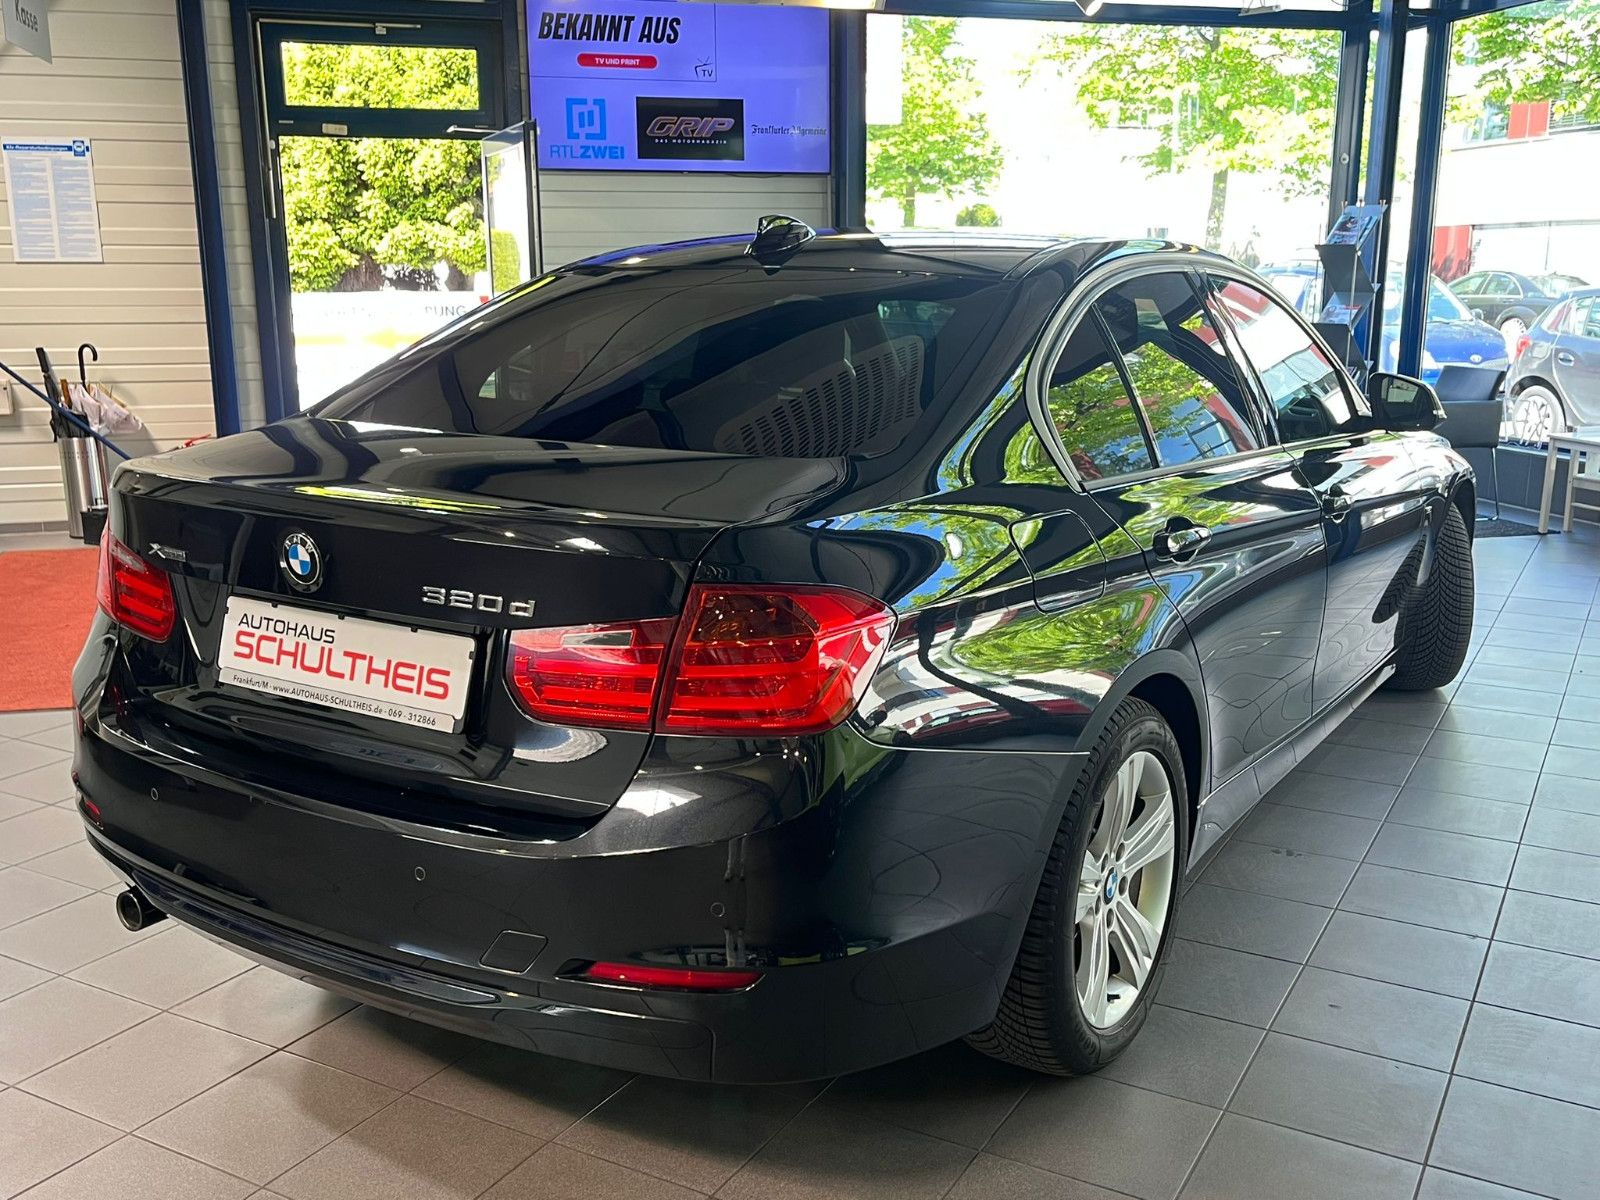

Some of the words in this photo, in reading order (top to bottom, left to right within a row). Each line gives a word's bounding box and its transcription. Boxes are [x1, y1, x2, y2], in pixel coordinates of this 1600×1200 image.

[15, 0, 38, 32] Kasse
[538, 12, 635, 42] BEKANNT
[638, 16, 681, 44] AUS
[701, 69, 713, 77] TV
[646, 116, 735, 138] GRIP
[751, 124, 790, 135] Frankfurter
[549, 144, 625, 159] RTLZWEI
[422, 586, 535, 617] 320d
[238, 613, 335, 644] AUTOHAUS
[233, 630, 451, 700] SCHULTHEIS
[233, 674, 268, 689] Frankfurt/M
[273, 684, 382, 714] www.AUTOHAUS-SCHULTHEIS.de
[388, 708, 402, 718] 069
[408, 712, 436, 726] 312866
